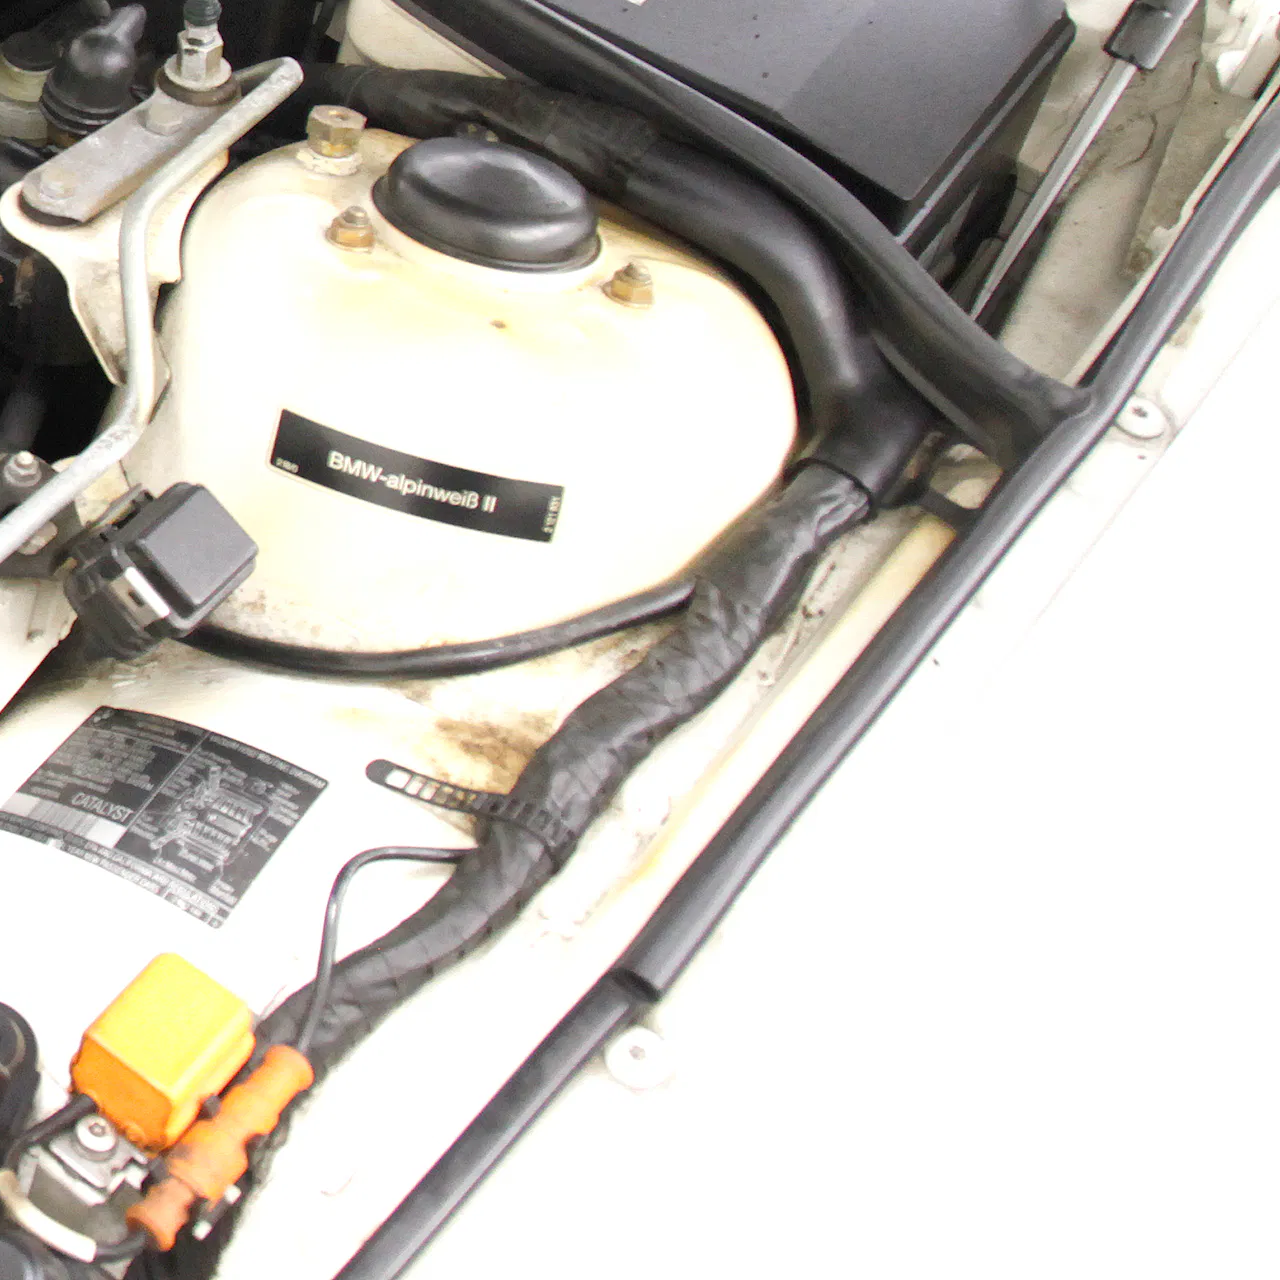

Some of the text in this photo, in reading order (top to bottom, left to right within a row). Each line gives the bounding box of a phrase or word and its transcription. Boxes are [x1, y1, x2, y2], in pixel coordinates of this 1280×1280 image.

[328, 451, 478, 509] BMW-alpinweiß
[481, 495, 498, 513] II
[71, 791, 134, 822] CATALYST
